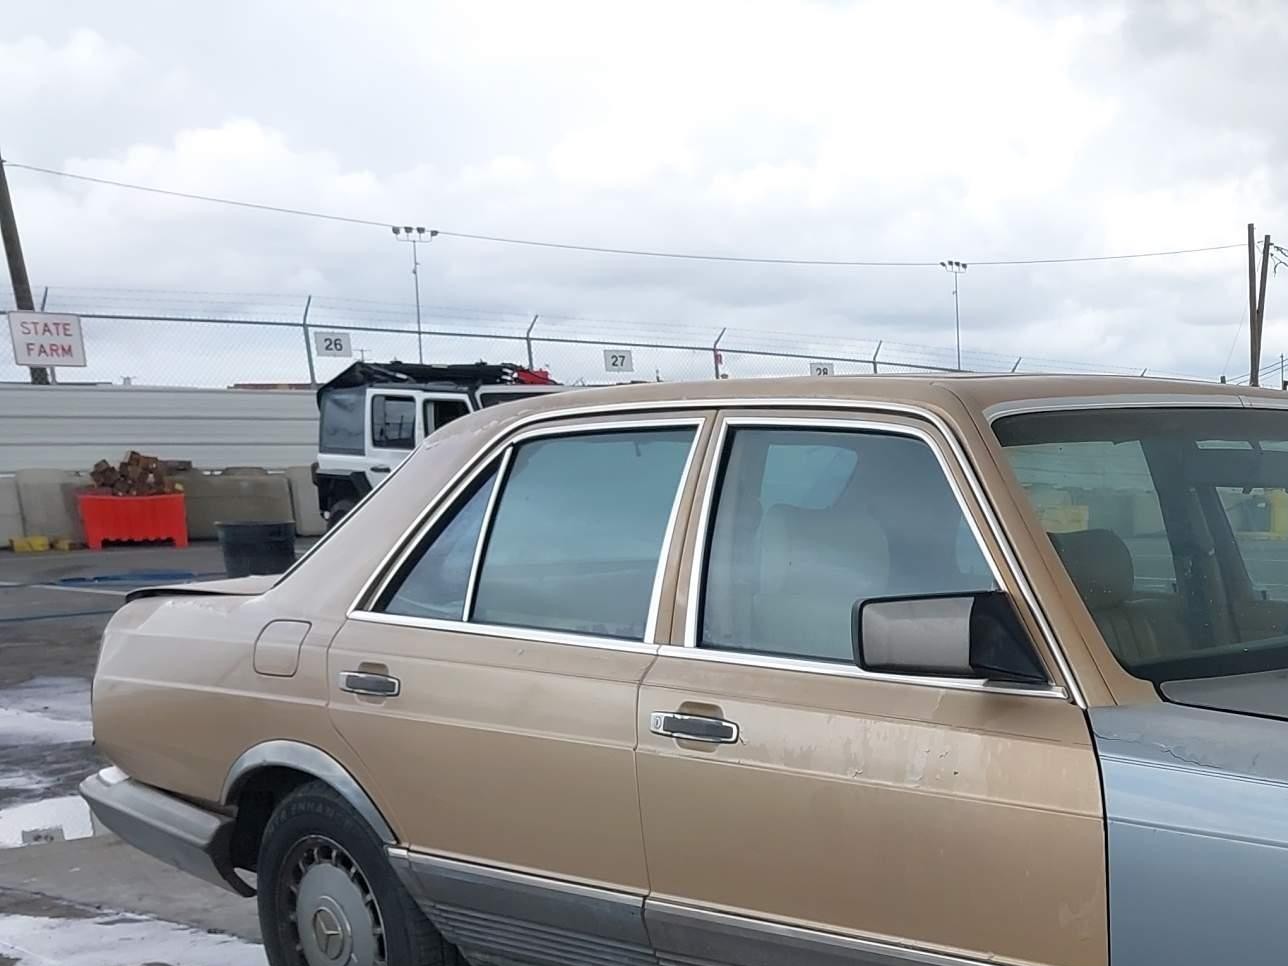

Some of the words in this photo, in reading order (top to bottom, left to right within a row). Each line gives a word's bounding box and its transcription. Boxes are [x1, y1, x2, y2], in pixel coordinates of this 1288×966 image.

[20, 321, 72, 336] STATE
[26, 342, 73, 358] FARM
[323, 337, 343, 351] 26
[610, 354, 626, 367] 27
[816, 367, 828, 376] 28
